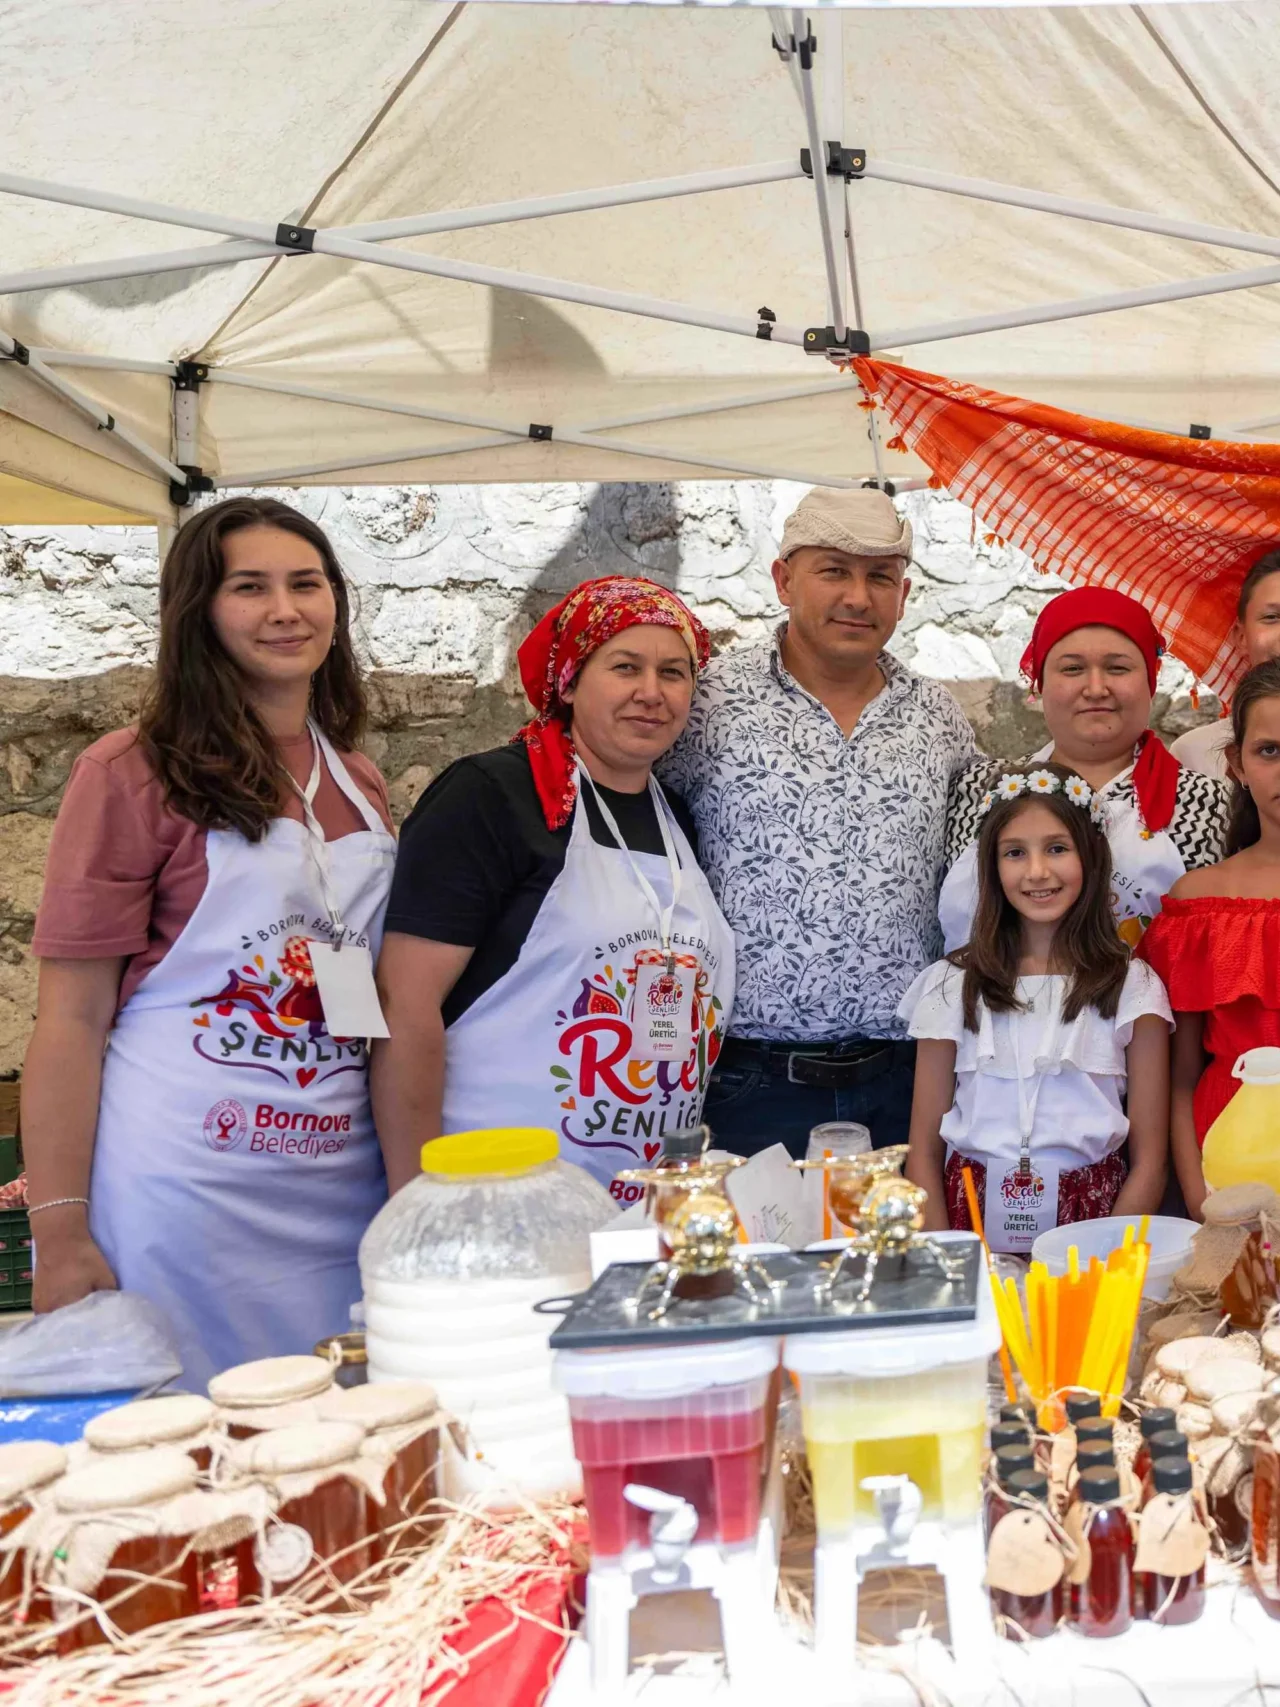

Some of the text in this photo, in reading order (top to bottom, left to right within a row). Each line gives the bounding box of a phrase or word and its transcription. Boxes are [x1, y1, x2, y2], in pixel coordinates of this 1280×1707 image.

[257, 914, 304, 942] BORNOVA
[608, 929, 659, 954] BORNOVA
[649, 1029, 677, 1038] ÜRETİCİ
[255, 1104, 351, 1132] Bornova
[250, 1132, 349, 1159] Belediyesi
[1001, 1184, 1041, 1199] Reçel
[1004, 1222, 1038, 1231] ÜRETİCİ
